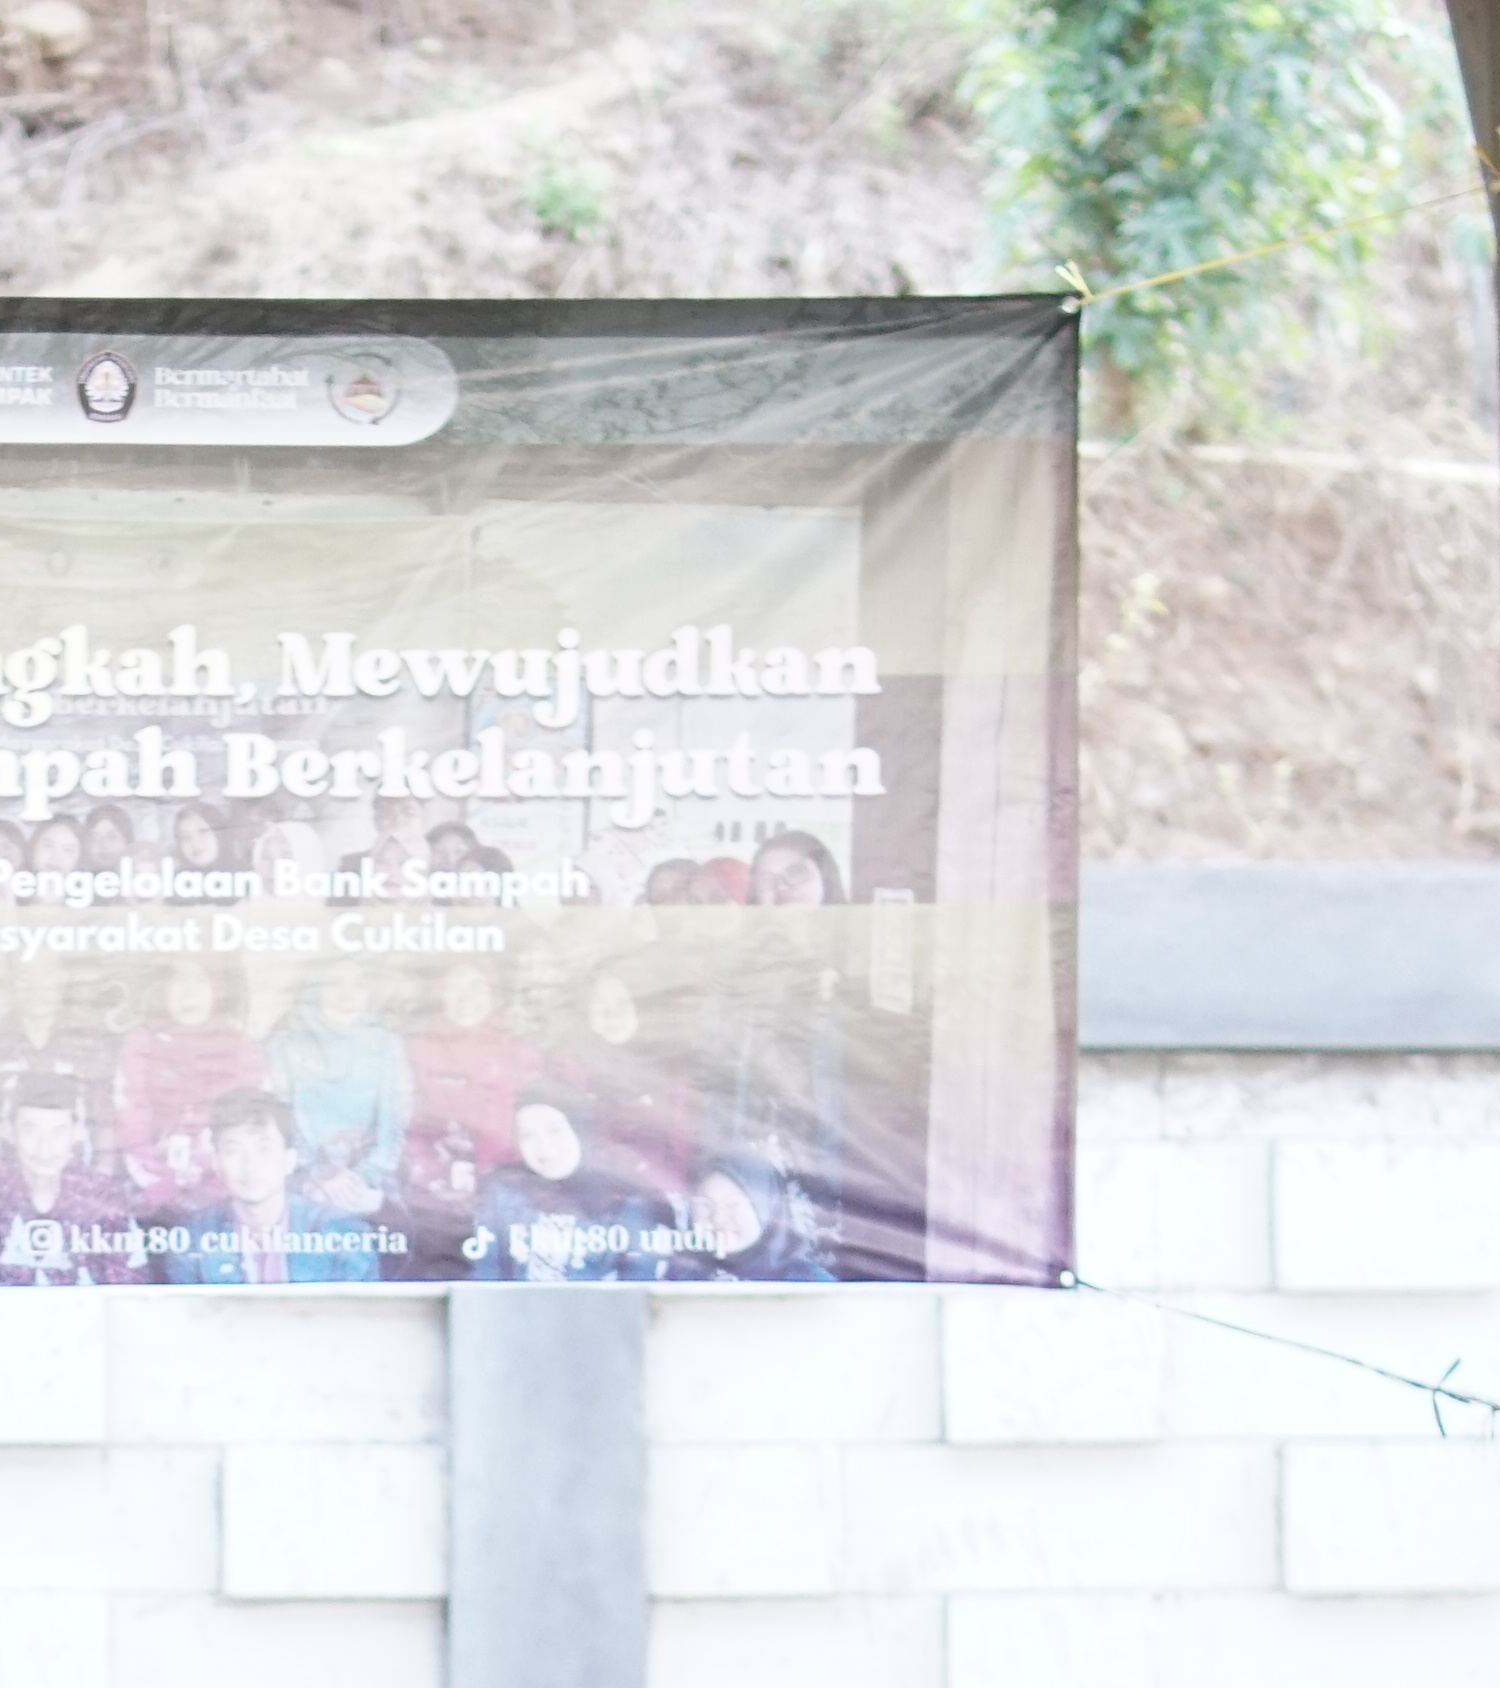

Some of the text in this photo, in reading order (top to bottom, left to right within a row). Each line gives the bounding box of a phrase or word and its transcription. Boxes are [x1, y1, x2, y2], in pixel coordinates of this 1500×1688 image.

[276, 624, 882, 729] Mewujudkan
[222, 725, 887, 830] Berkelanjutan
[273, 859, 387, 899] Bank
[401, 859, 591, 909] Sampah
[213, 914, 319, 953] Desa
[331, 913, 506, 954] Cukilan
[70, 1225, 408, 1258] kknt80_cukilanceria
